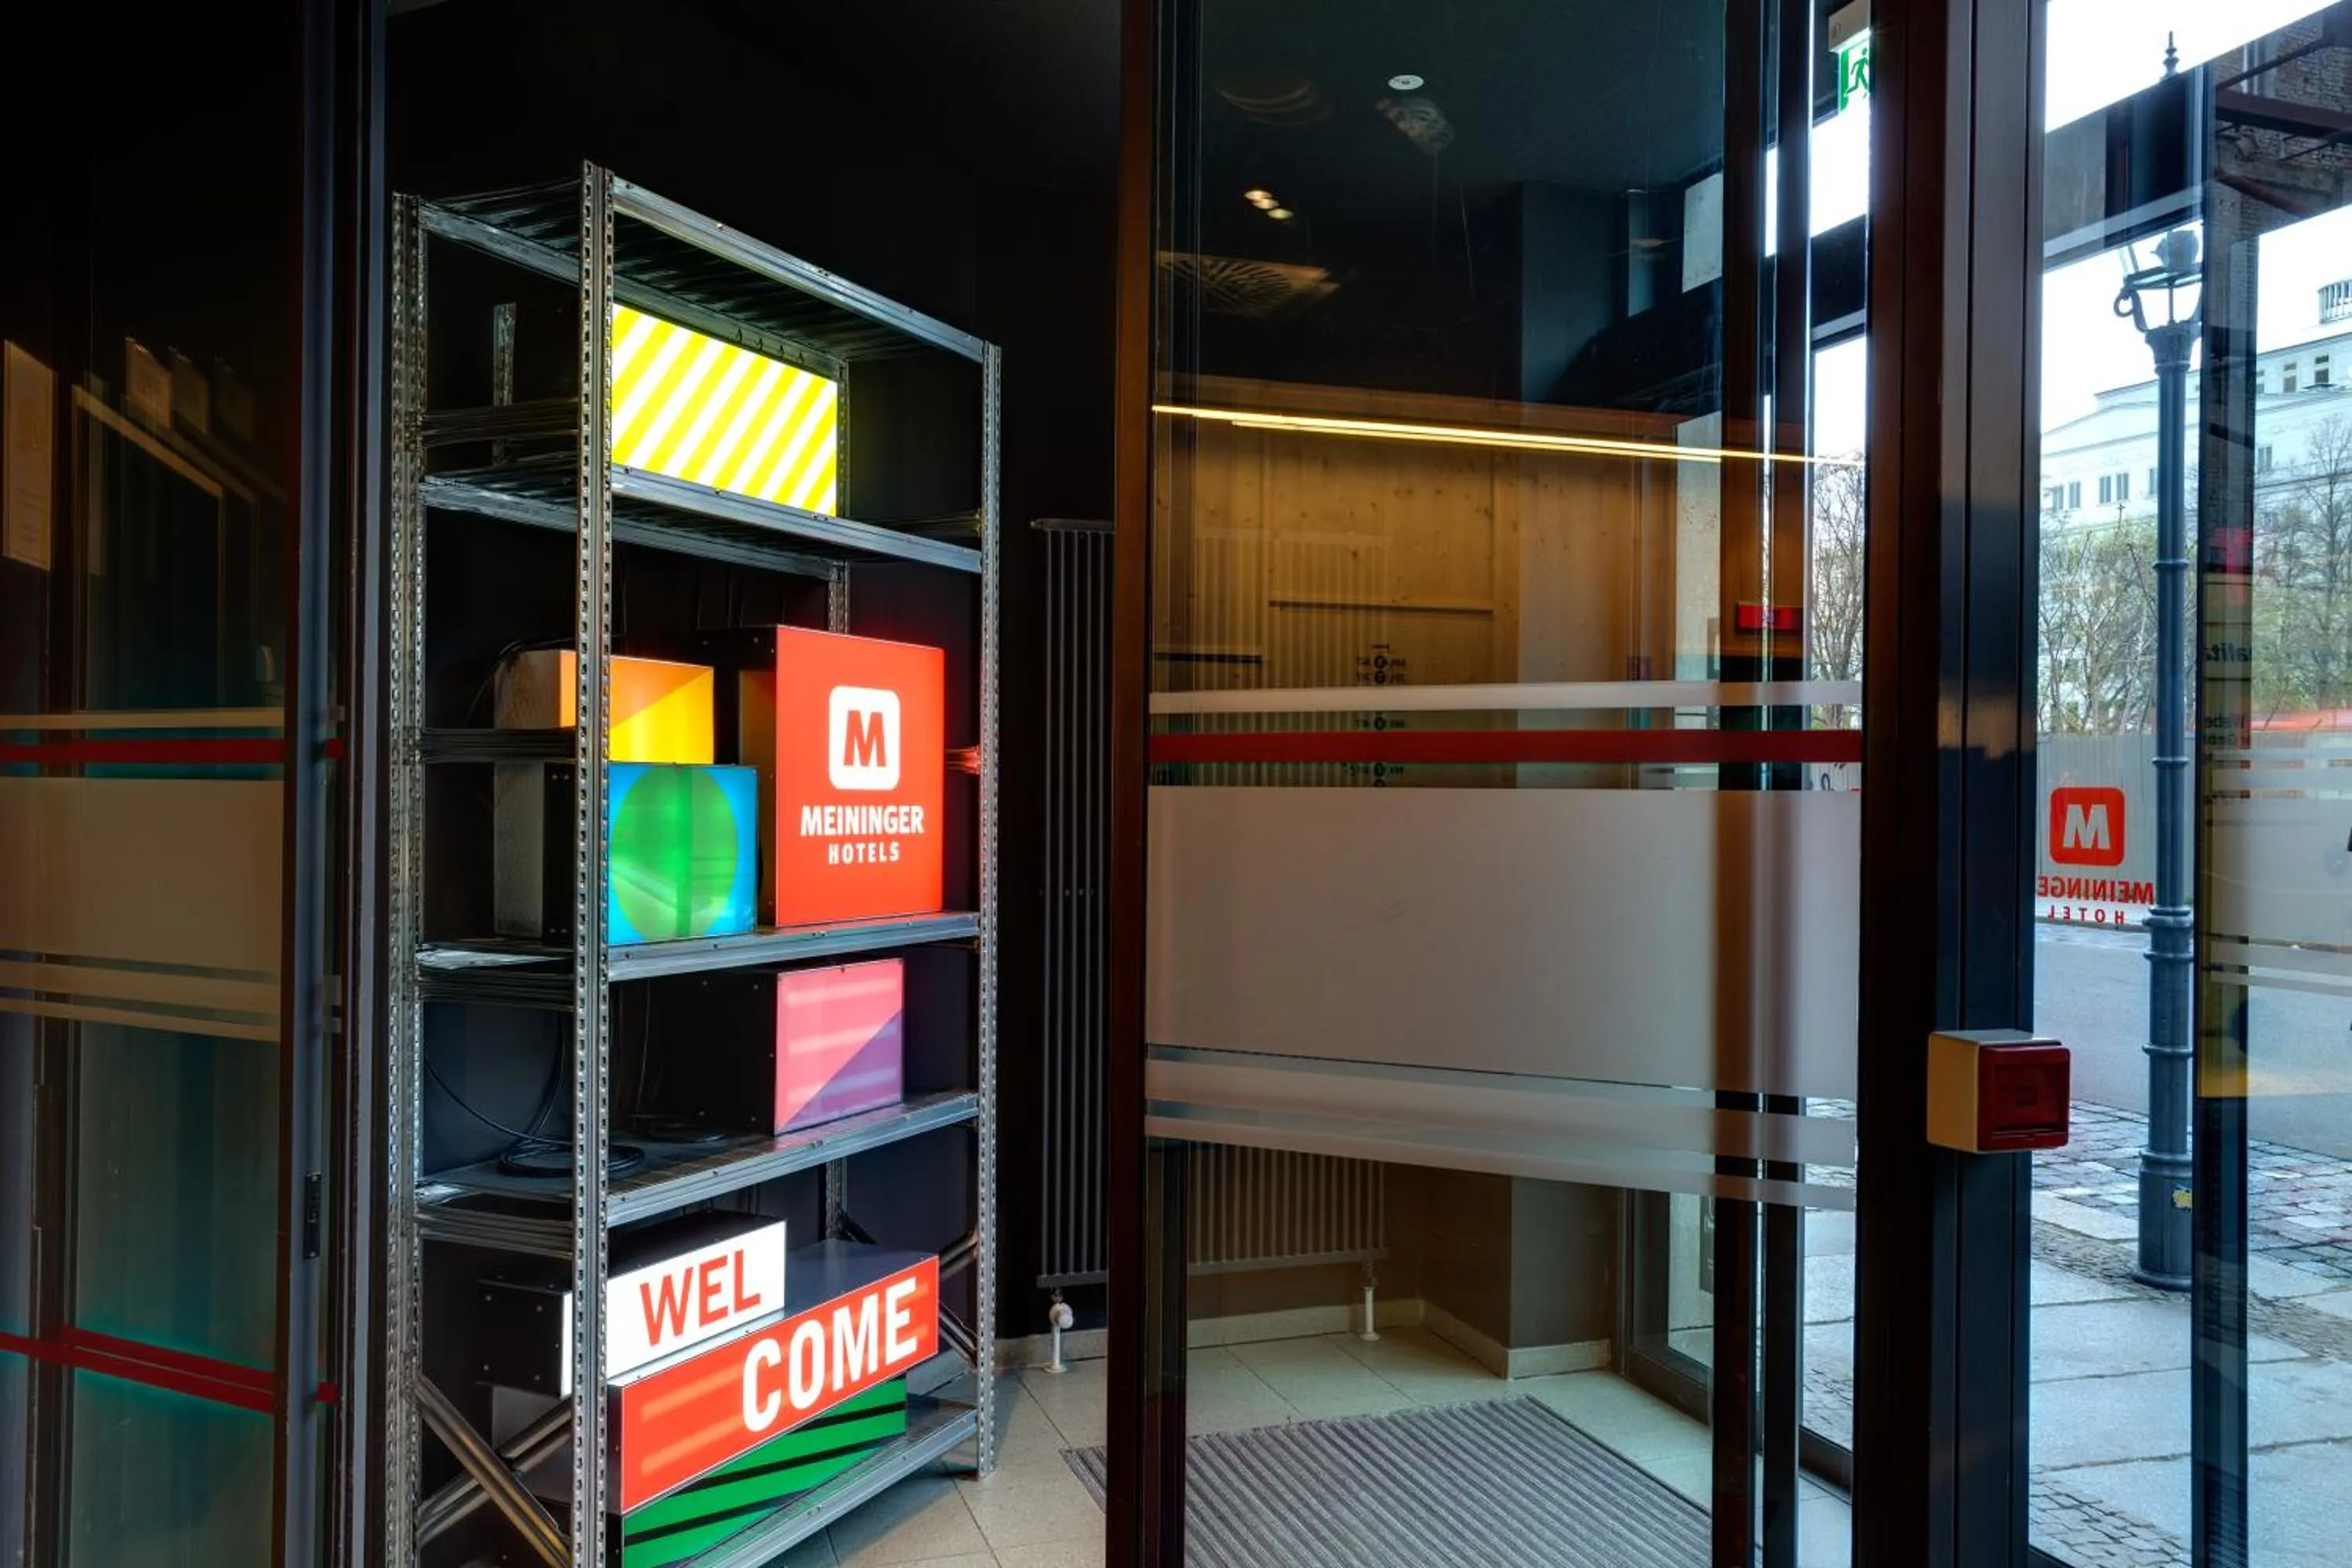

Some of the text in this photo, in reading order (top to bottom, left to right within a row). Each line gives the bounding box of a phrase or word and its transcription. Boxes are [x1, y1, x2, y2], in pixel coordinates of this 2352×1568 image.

[843, 710, 887, 768] M
[800, 805, 924, 837] MEININGER
[829, 842, 900, 864] HOTELS
[639, 1249, 761, 1348] WEL
[742, 1276, 917, 1432] COME
